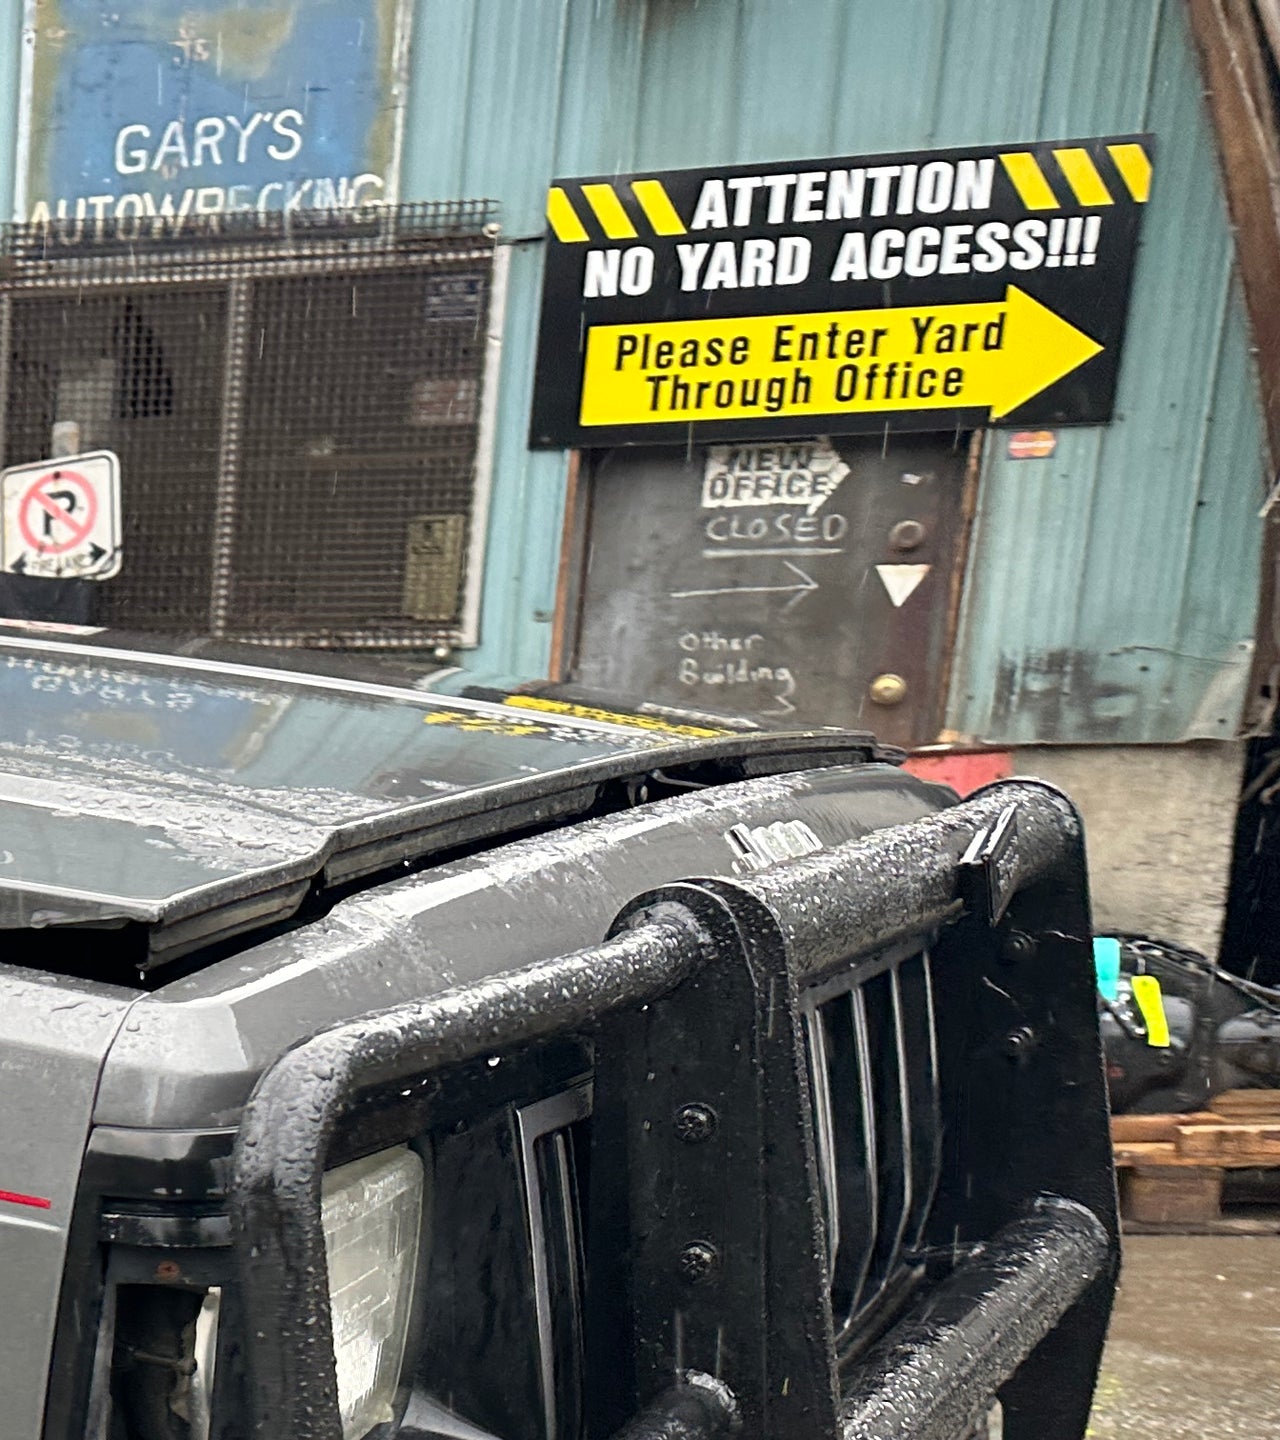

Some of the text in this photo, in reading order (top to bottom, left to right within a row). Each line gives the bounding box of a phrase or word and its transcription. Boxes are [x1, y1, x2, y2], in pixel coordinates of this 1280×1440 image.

[114, 108, 304, 175] GARY'S
[690, 158, 996, 231] ATTENTION
[583, 215, 1103, 298] NO YARD ACCESS!!!
[614, 311, 1007, 371] Please Enter Yard
[645, 361, 965, 412] Through Office
[709, 472, 830, 499] OFFICE
[705, 513, 848, 542] CLOSED
[678, 631, 765, 651] Other
[678, 657, 797, 699] Building
